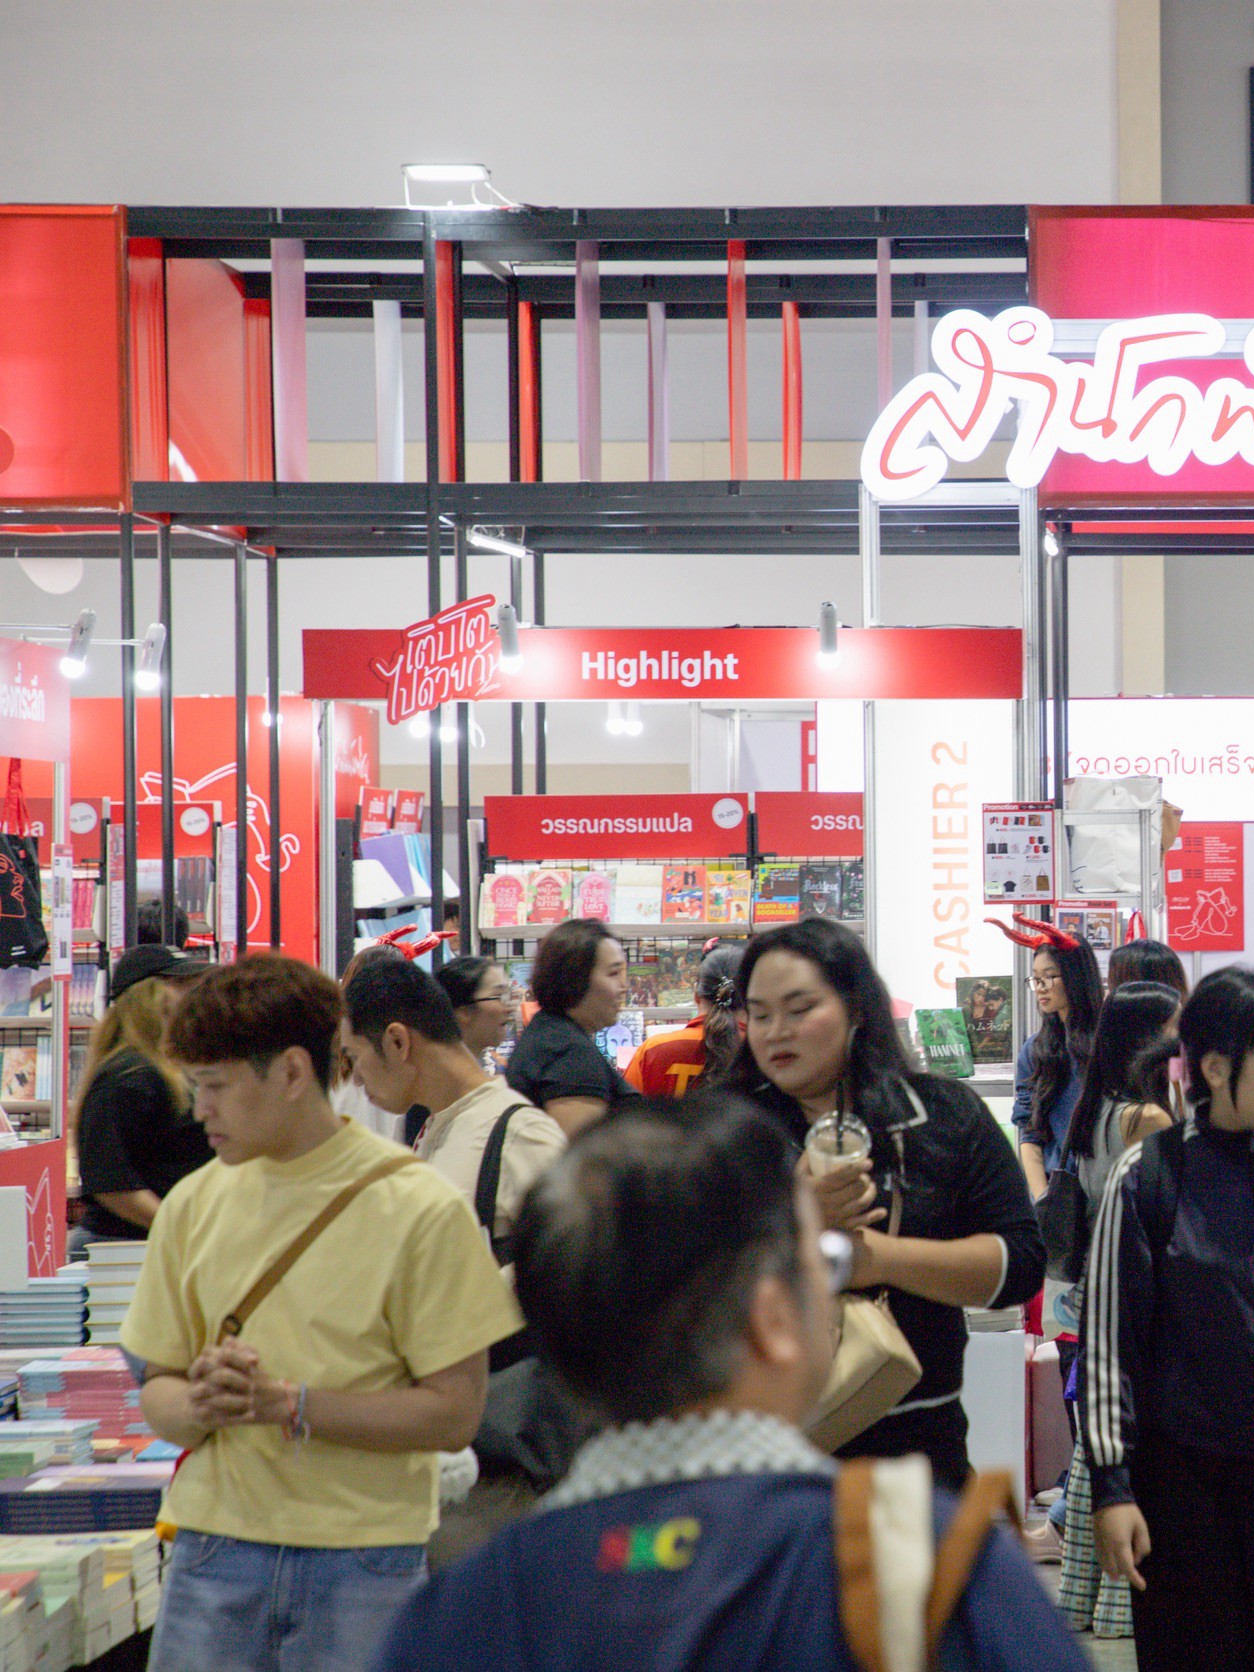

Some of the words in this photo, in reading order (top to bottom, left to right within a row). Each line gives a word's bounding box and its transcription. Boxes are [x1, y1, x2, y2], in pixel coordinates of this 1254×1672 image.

[581, 650, 739, 688] Highlight
[931, 740, 968, 765] 2
[541, 812, 693, 835] วรรณกรรมแปล
[810, 814, 864, 831] วรรณ
[932, 782, 971, 991] CASHIER
